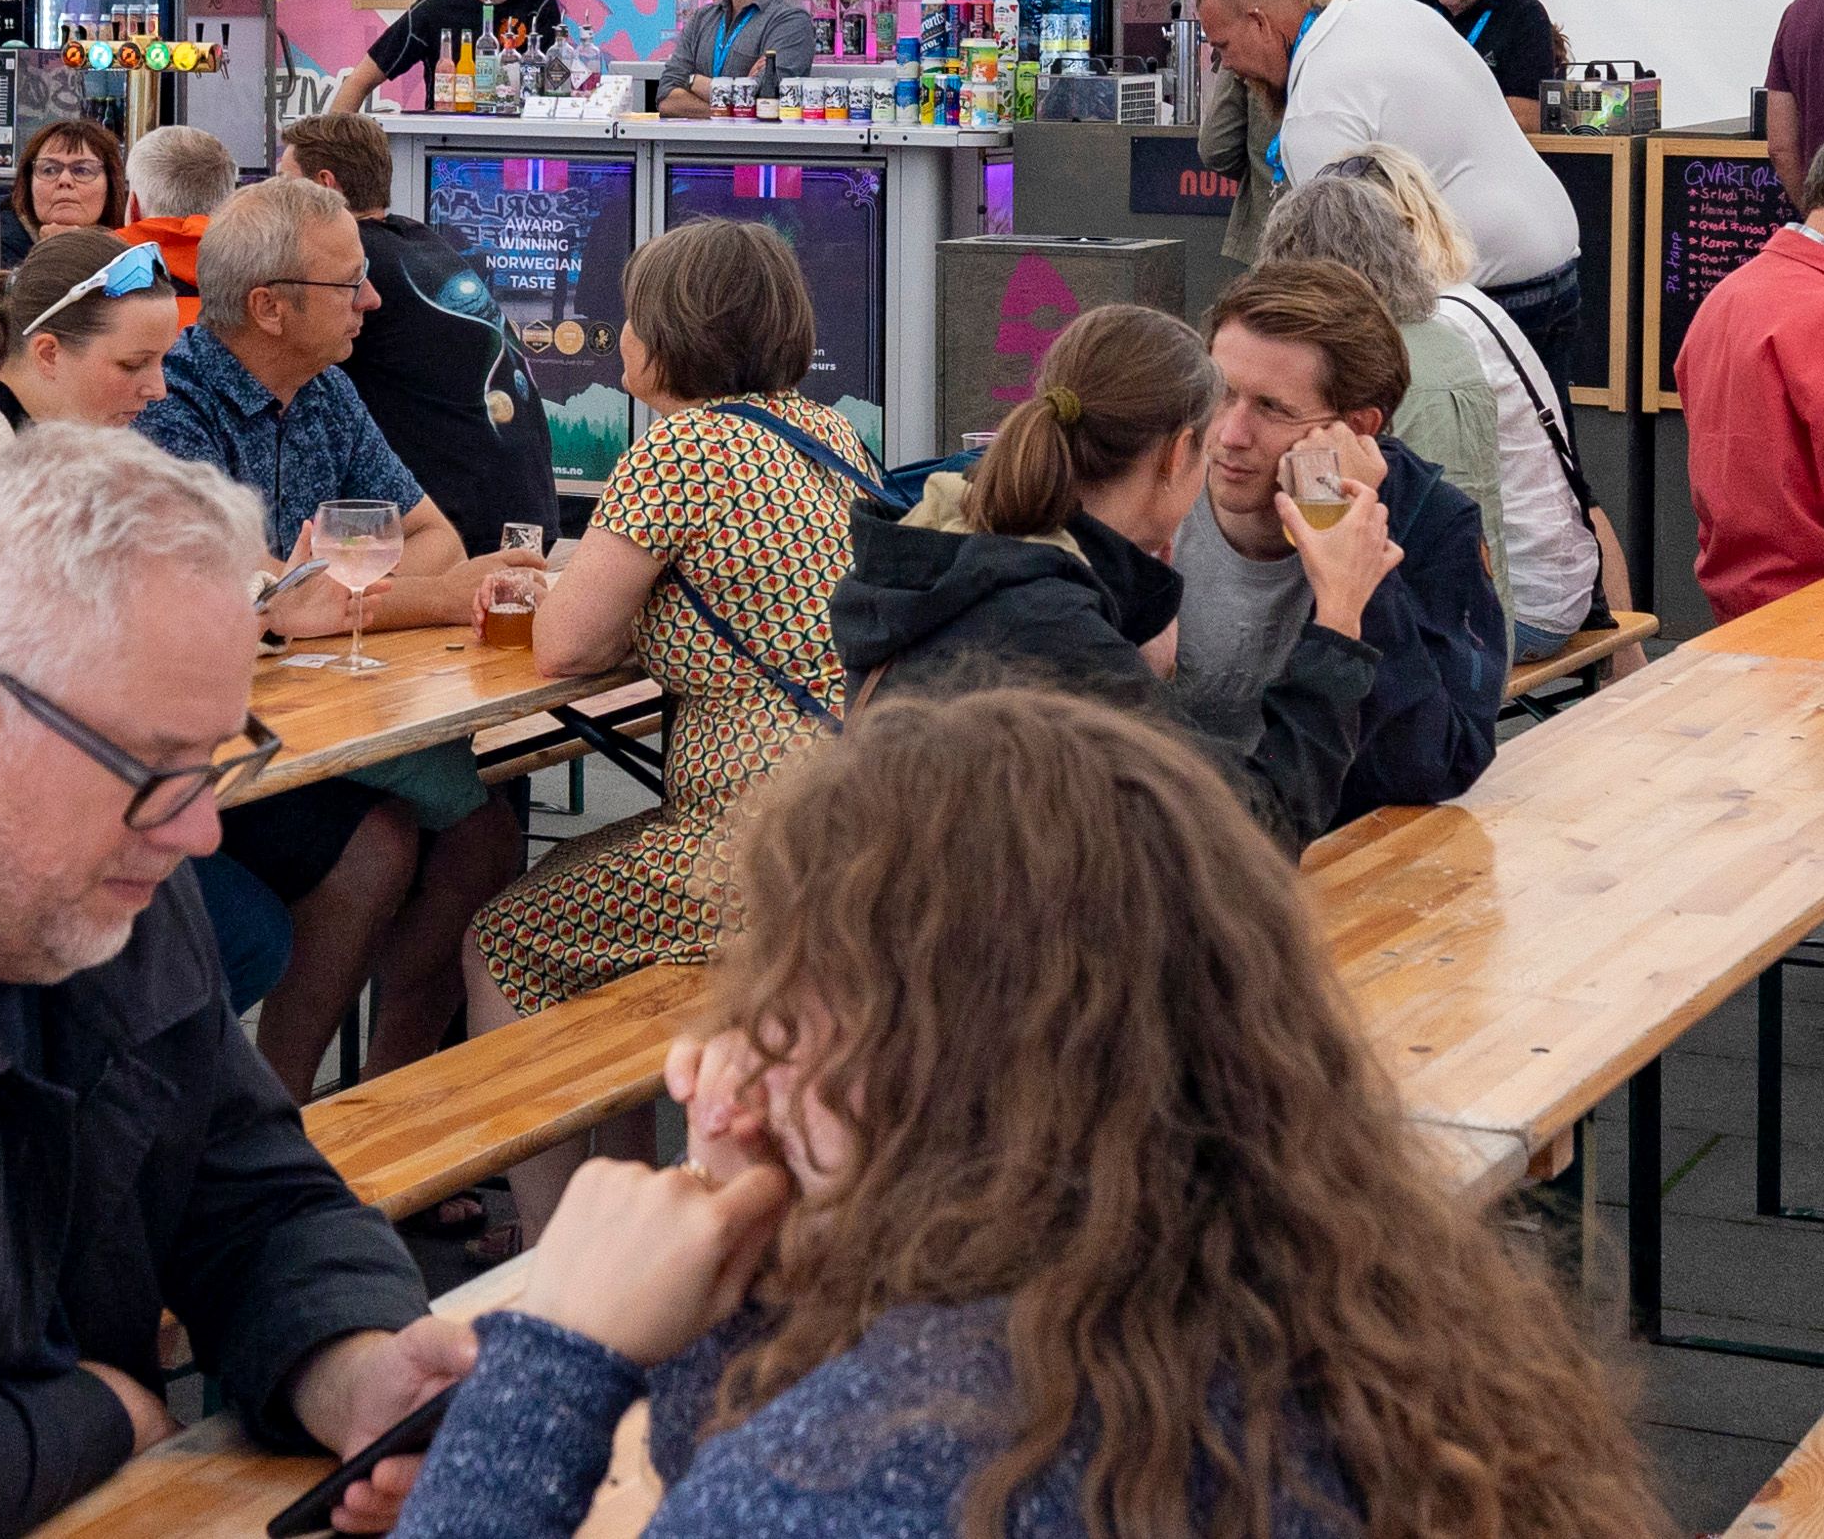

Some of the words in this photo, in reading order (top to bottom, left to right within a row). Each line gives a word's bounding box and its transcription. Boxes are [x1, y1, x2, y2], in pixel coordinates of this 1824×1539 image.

[506, 219, 564, 233] AWARD
[499, 237, 569, 252] WINNING
[486, 255, 582, 272] NORWEGIAN
[509, 275, 556, 290] TASTE
